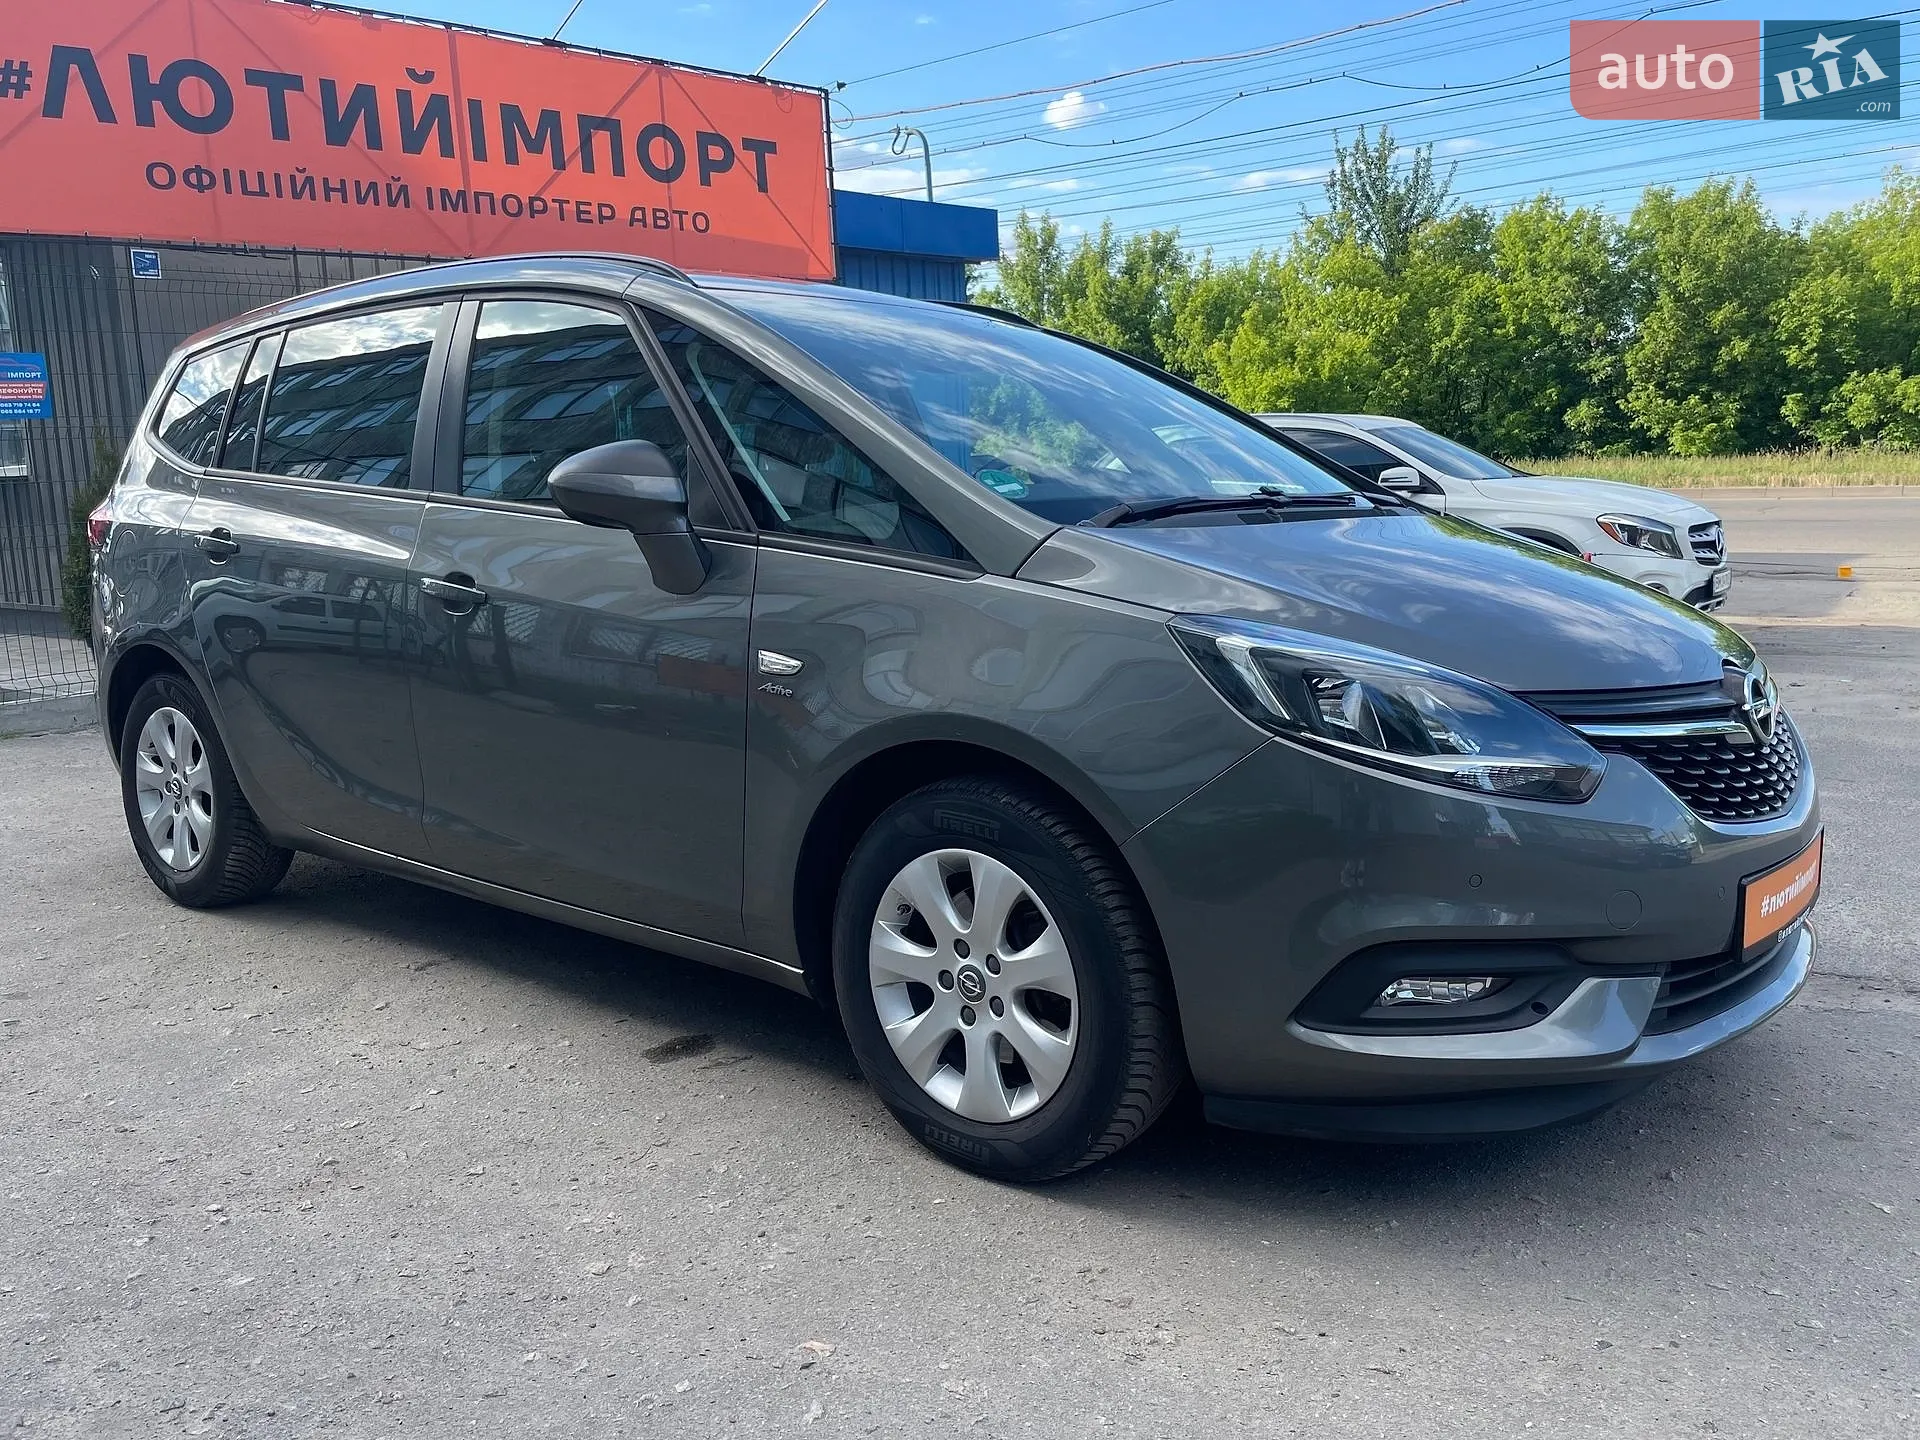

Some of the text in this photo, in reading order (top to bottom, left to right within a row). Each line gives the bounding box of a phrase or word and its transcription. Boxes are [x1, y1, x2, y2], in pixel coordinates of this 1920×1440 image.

[0, 45, 777, 194] #ЛЮТИЙІМПОРТ
[145, 161, 710, 234] ОФІЦІЙНИЙ ІМПОРТЕР АВТО
[757, 682, 793, 697] Active
[933, 808, 1000, 842] PIRELLI
[922, 1121, 990, 1167] PIRELLI
